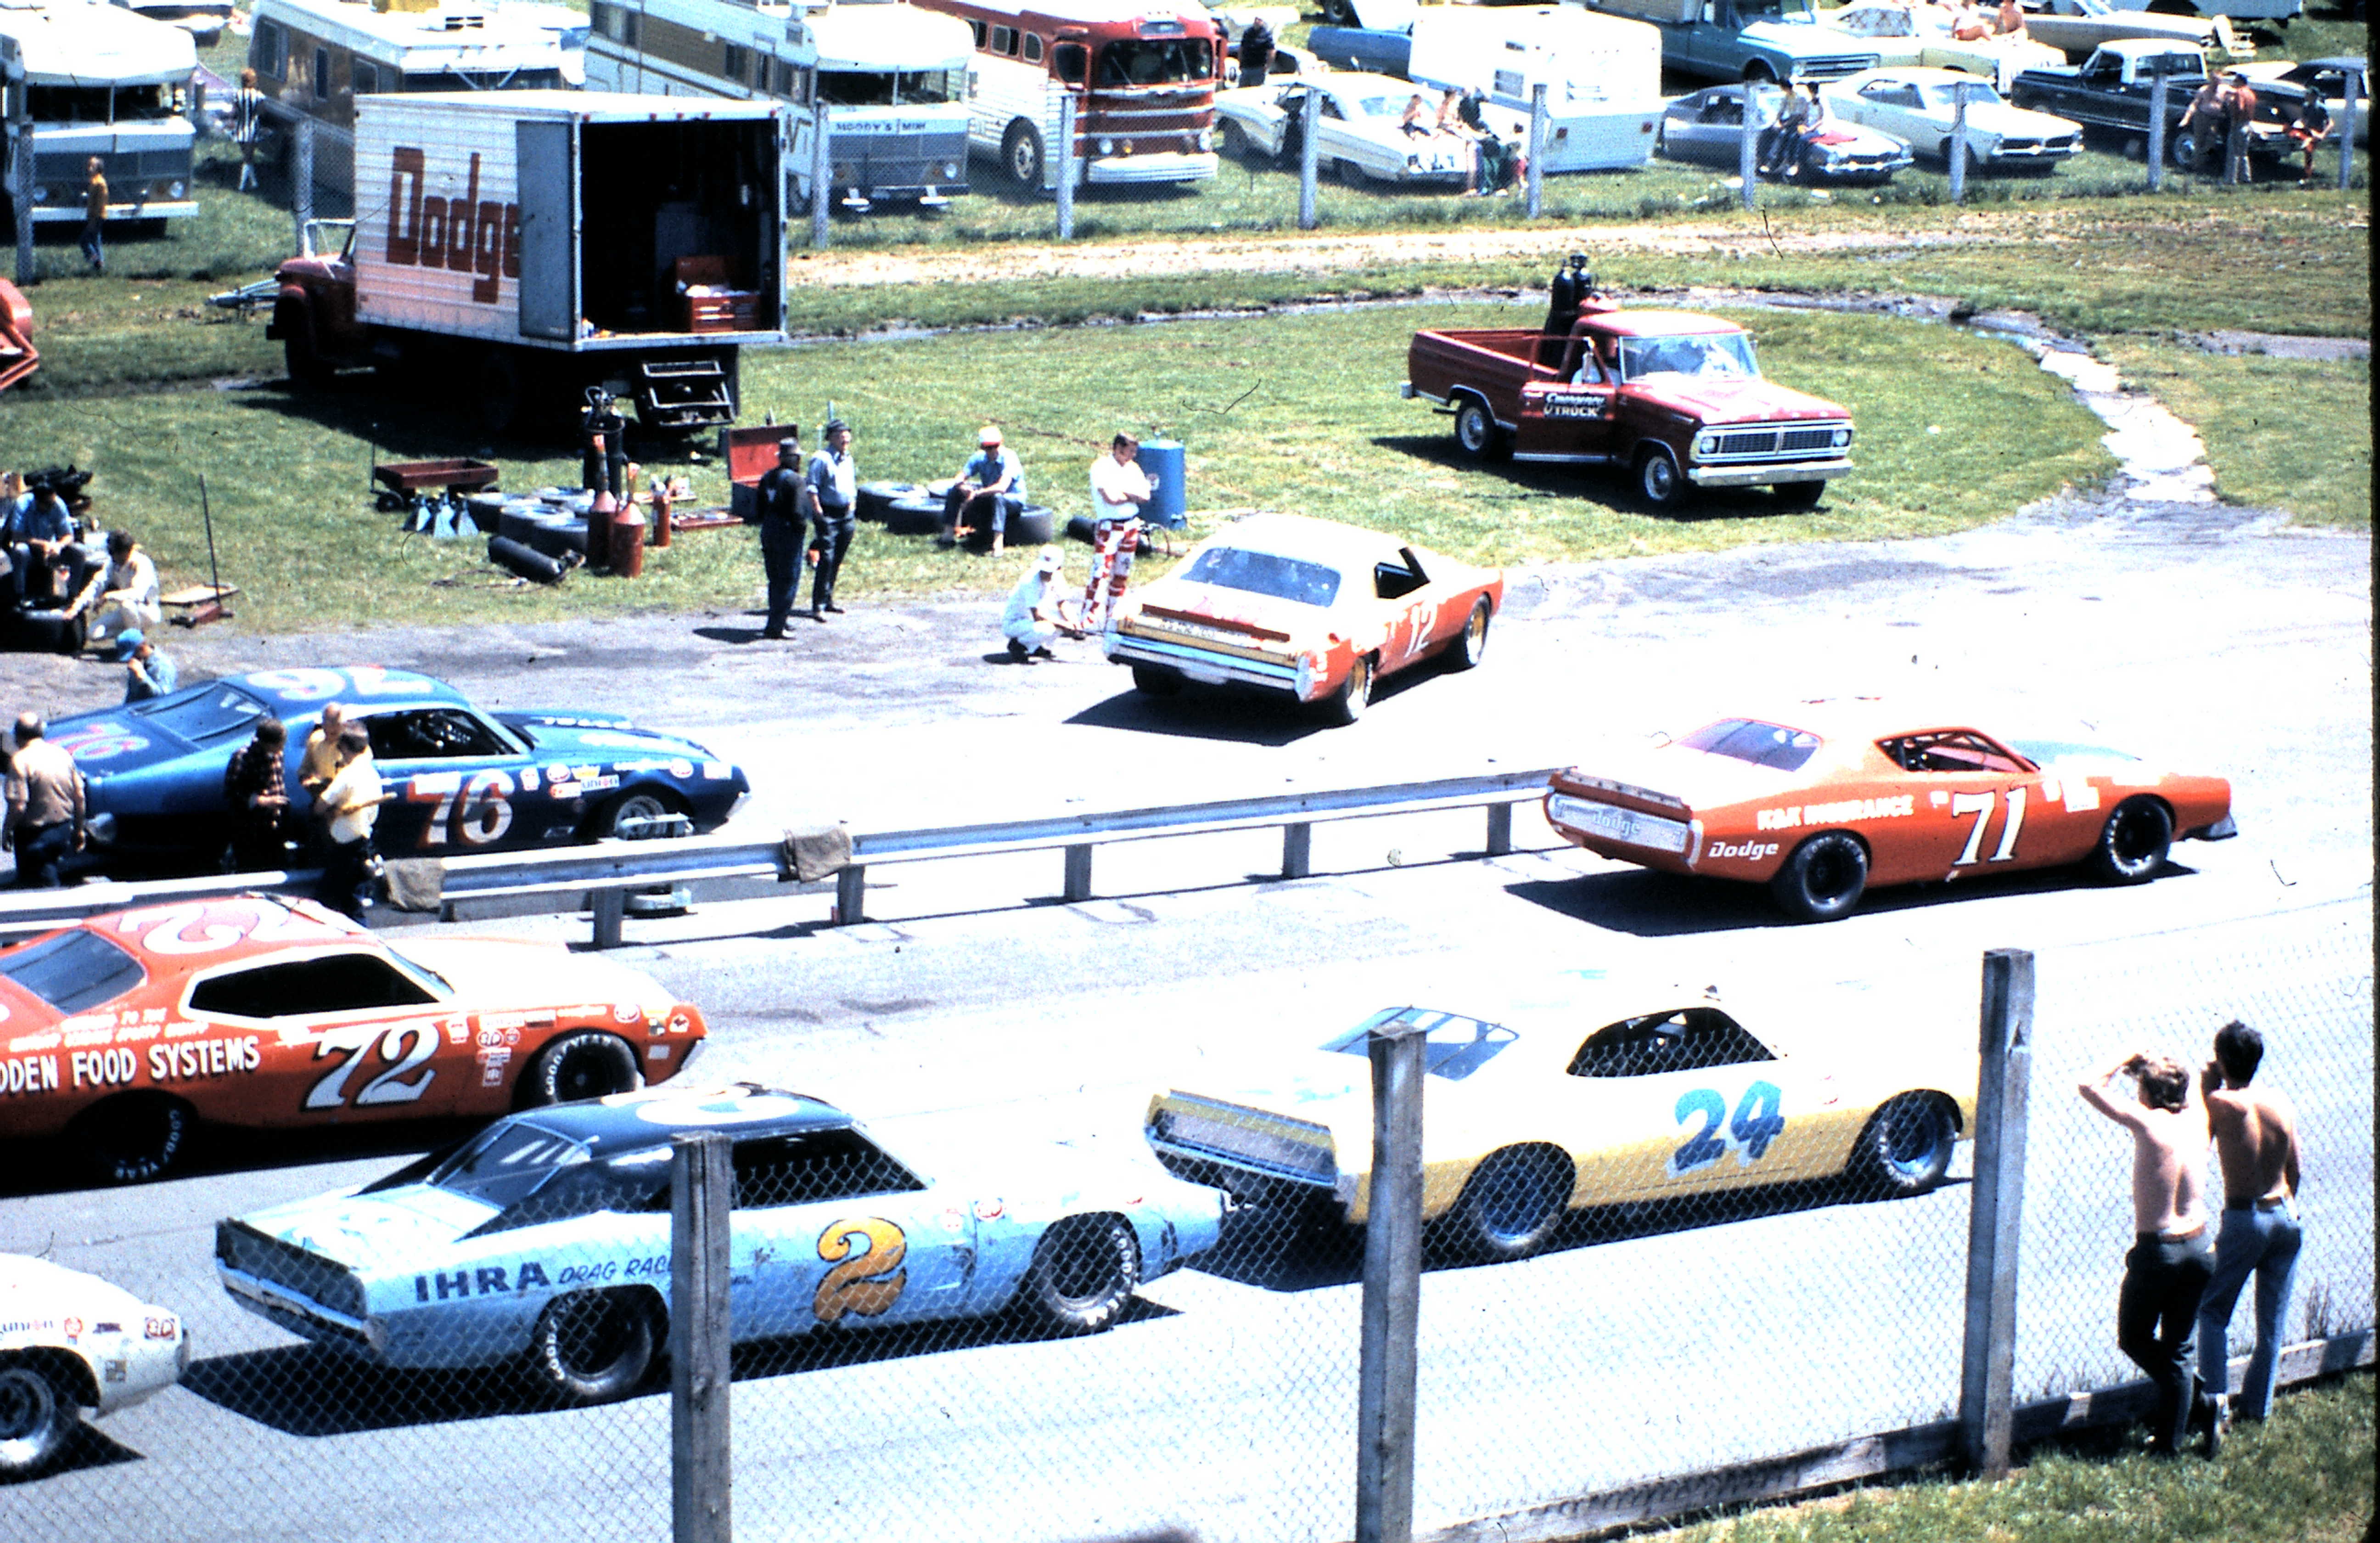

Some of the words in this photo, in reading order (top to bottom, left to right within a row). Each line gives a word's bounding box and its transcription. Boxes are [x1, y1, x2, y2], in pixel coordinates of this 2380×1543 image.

[386, 146, 520, 304] Dodge
[1554, 405, 1600, 417] TRUCK
[407, 768, 515, 848] 76
[1591, 810, 1640, 834] Dodge
[1952, 786, 2028, 867] 71
[1709, 841, 1779, 860] Dodge
[71, 1047, 137, 1087] FOOD
[148, 1036, 261, 1080] SYSTEMS
[299, 1019, 441, 1111] 72
[1671, 1080, 1785, 1174] 24
[415, 1262, 550, 1302] IHRA
[559, 1261, 617, 1284] DRAG
[624, 1255, 672, 1276] RAC
[813, 1216, 907, 1322] 2
